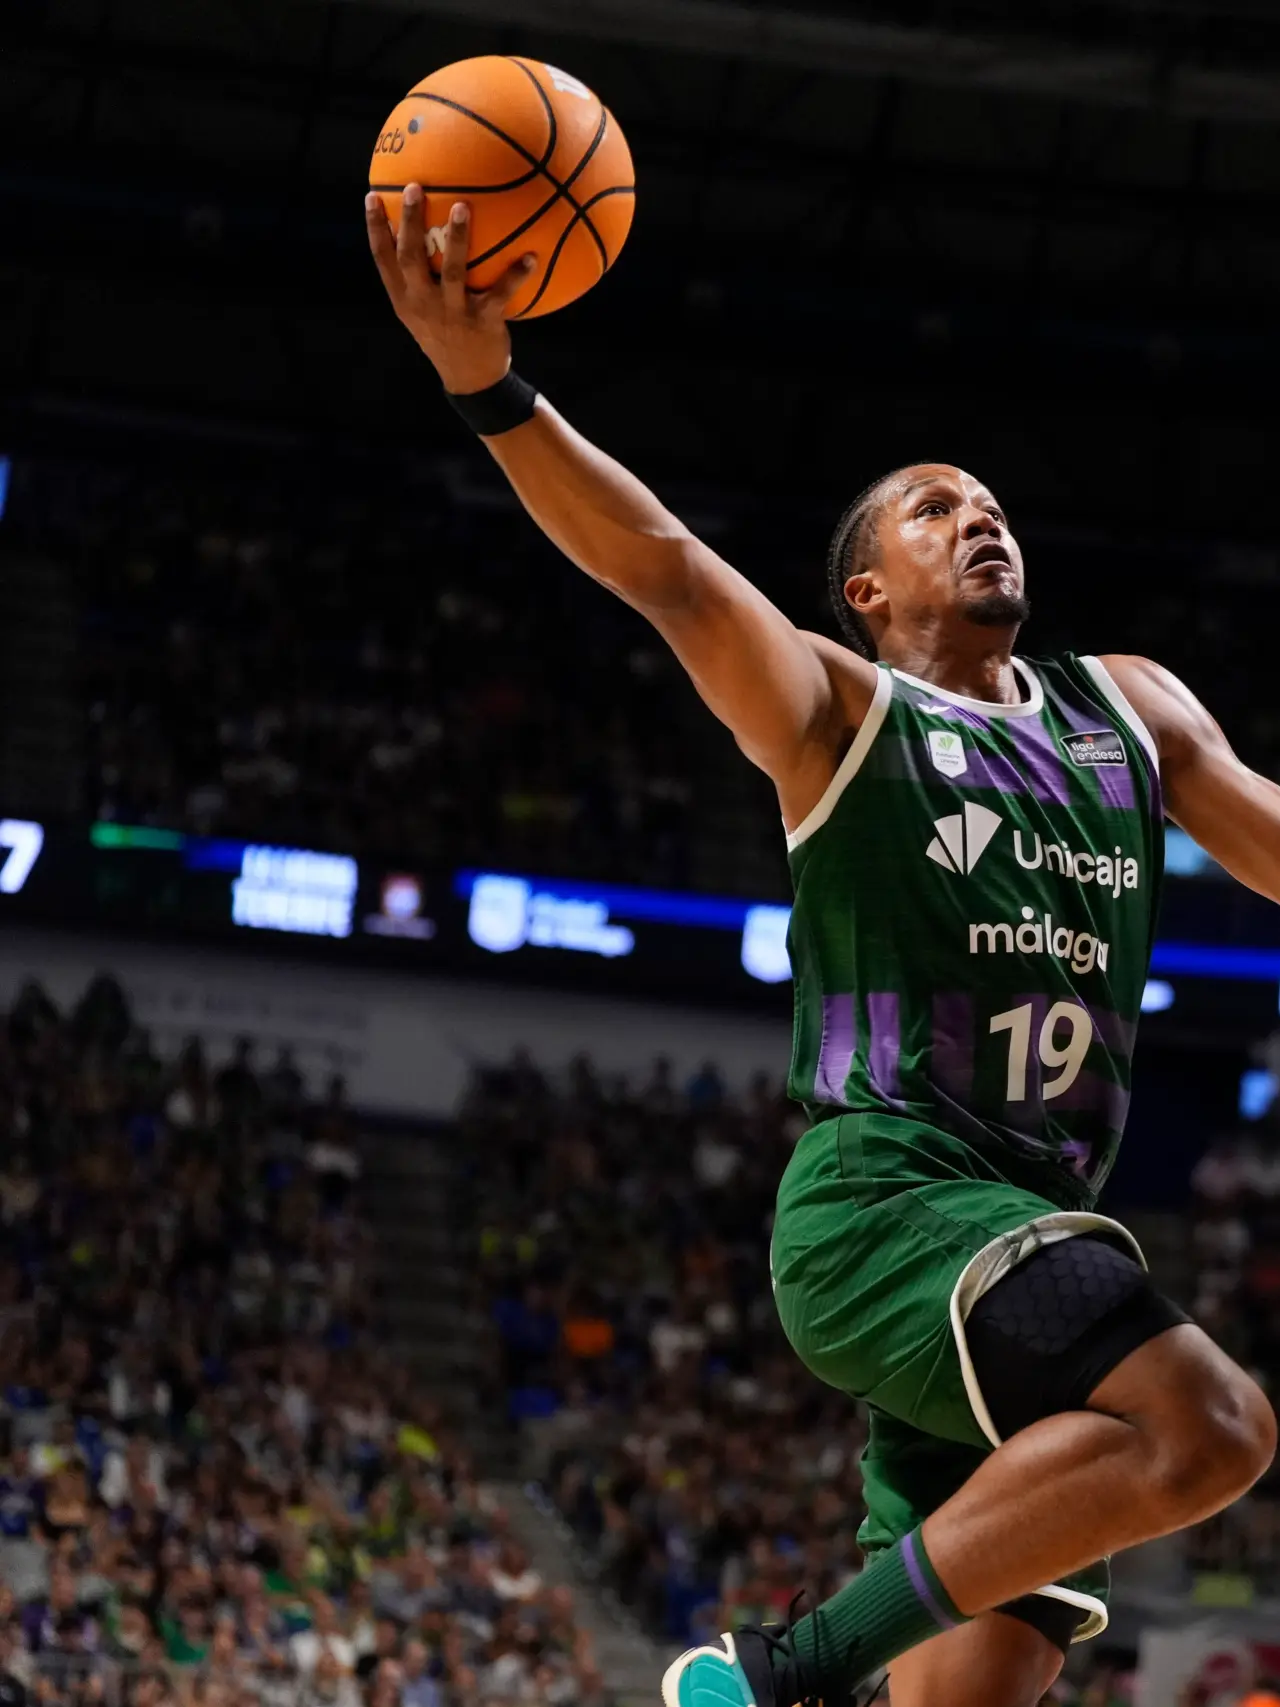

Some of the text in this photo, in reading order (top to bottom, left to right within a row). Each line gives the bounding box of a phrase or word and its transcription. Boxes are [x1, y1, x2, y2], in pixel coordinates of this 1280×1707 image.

[1077, 750, 1123, 760] endesa
[1013, 830, 1138, 898] Unicaja
[989, 1001, 1093, 1102] 19
